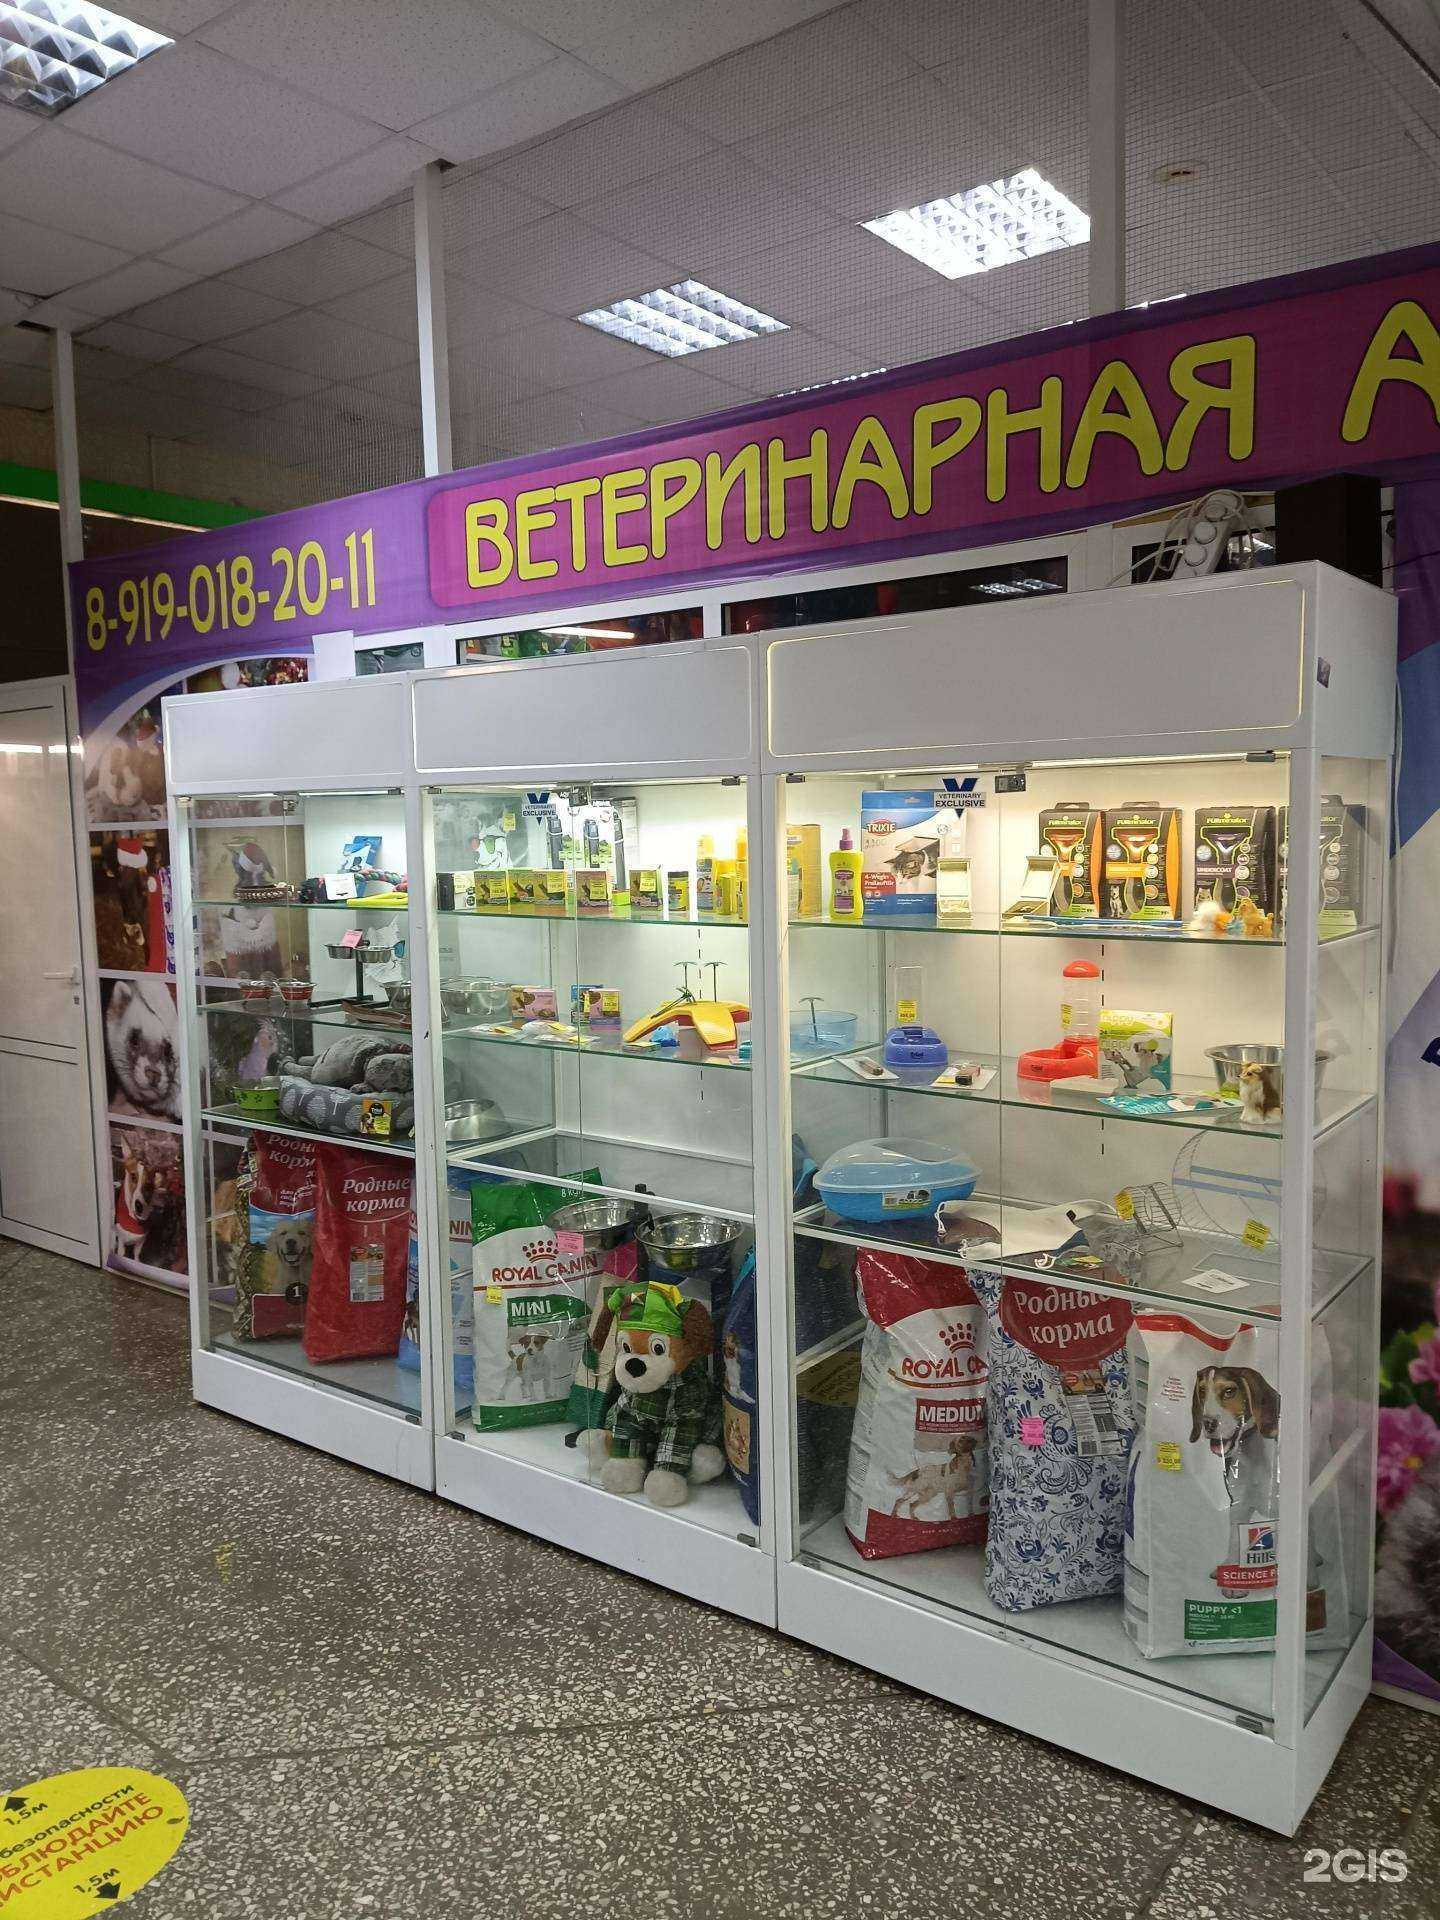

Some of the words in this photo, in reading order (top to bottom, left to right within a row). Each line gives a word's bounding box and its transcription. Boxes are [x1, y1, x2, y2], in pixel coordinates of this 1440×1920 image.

[464, 334, 1256, 590] ВЕТЕРИНАРНАЯ
[85, 527, 377, 652] 8-919-018-20-11
[935, 799, 985, 808] EXCLUSIVE
[938, 792, 982, 800] VETERINARY
[867, 822, 896, 833] TRIXIE
[266, 1133, 316, 1153] Родн
[269, 1150, 316, 1169] корм
[342, 1175, 411, 1195] Родные
[346, 1194, 407, 1216] корма
[491, 1265, 543, 1282] ROYAL
[545, 1253, 599, 1278] CANIN
[511, 1300, 552, 1317] MINI
[1029, 1313, 1115, 1349] корма
[901, 1357, 965, 1379] ROYAL
[1223, 1570, 1269, 1579] SCIENCE
[1189, 1603, 1227, 1613] PUPPY
[0, 1784, 135, 1859] безопасности
[3, 1801, 49, 1826] 1,5м
[0, 1791, 152, 1882] БЛЮДАЙТЕ
[0, 1806, 164, 1908] ИСТАНЦИЮ
[73, 1867, 121, 1894] 1,5м
